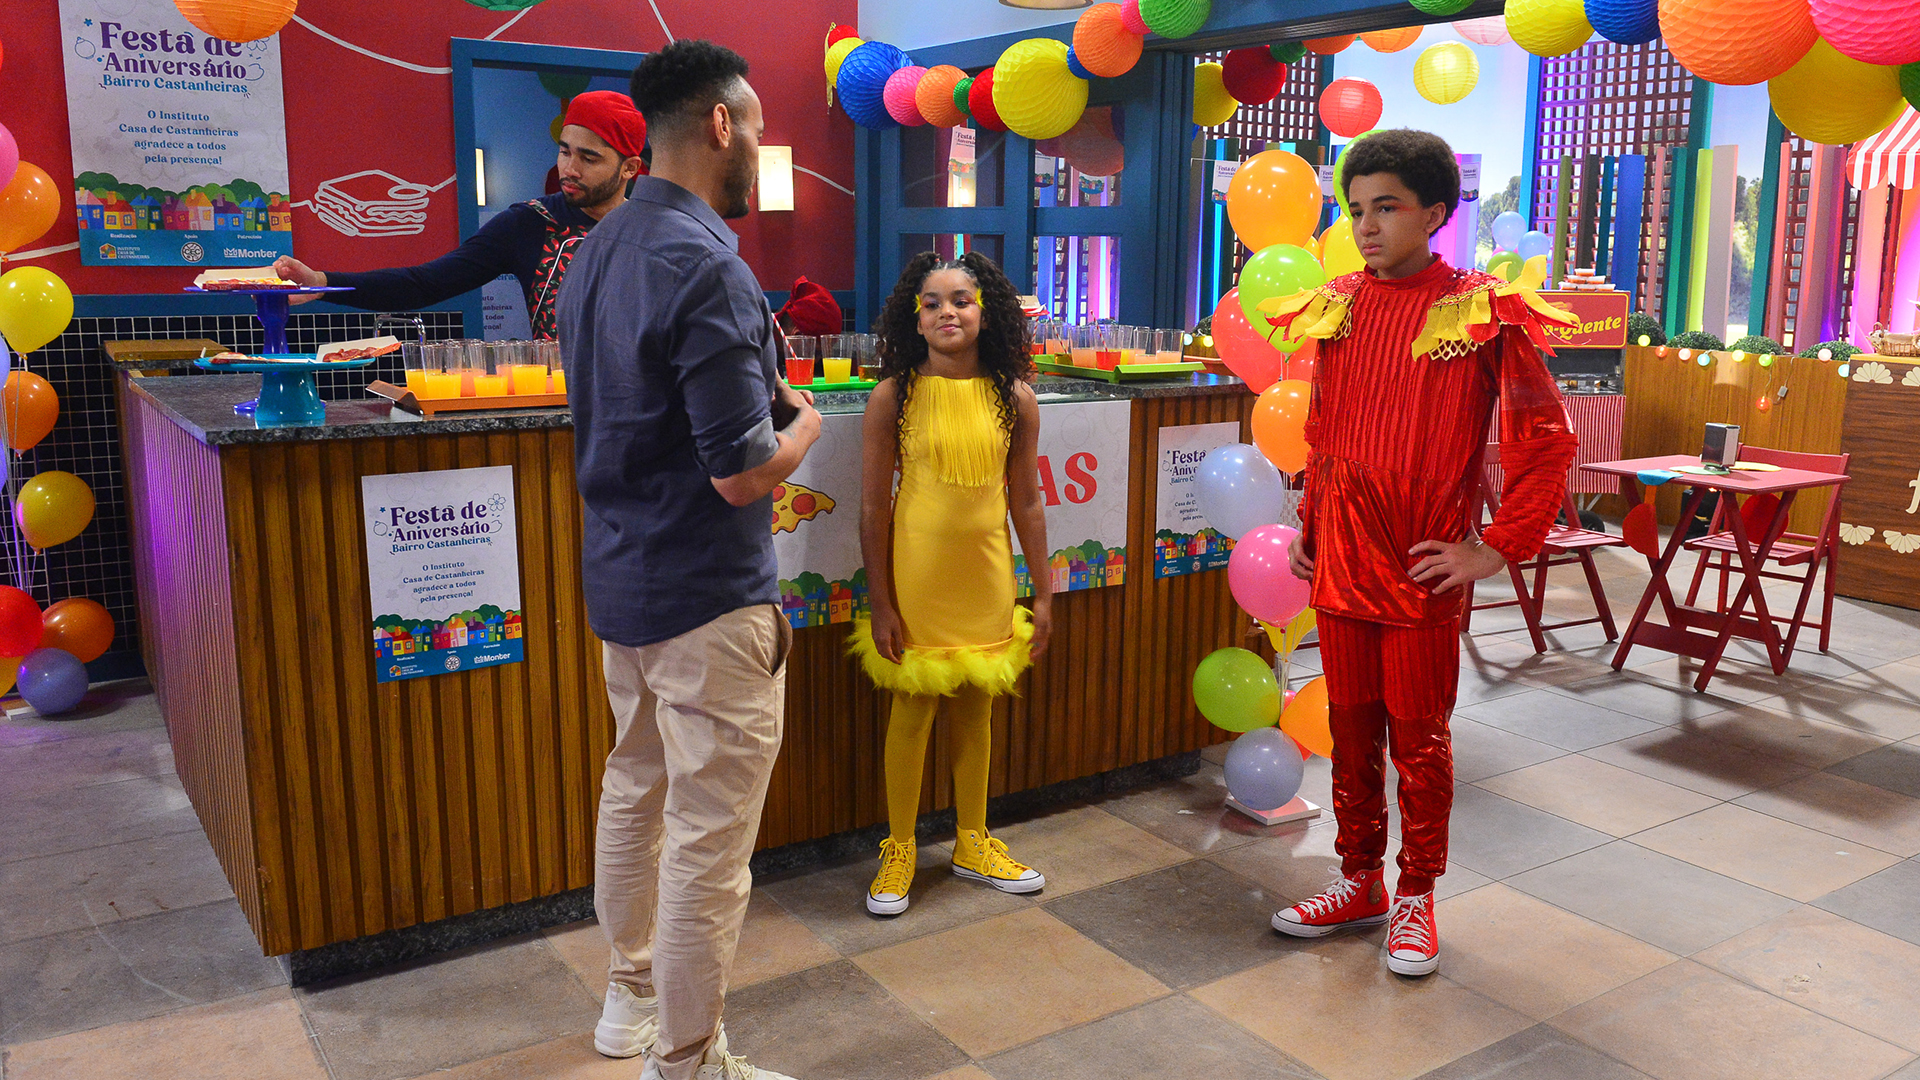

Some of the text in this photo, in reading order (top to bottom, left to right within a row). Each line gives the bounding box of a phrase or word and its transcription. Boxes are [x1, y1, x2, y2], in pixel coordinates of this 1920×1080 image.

[100, 21, 196, 54] Festa
[104, 52, 247, 79] Aniversário
[103, 74, 248, 93] Bairro Castanheiras
[147, 110, 210, 121] O Instituto
[119, 123, 239, 137] Casa de Castanheiras
[134, 140, 184, 150] agradece
[196, 142, 227, 150] todos
[144, 154, 222, 165] pela presença!
[238, 249, 277, 258] Monter
[1037, 452, 1098, 507] AS
[391, 500, 488, 526] Festa de
[393, 521, 490, 542] Aniversário
[392, 536, 491, 553] Bairro Castanheiras
[430, 561, 465, 571] Instituto
[403, 576, 423, 584] Casa
[434, 569, 485, 580] Castanheiras
[413, 583, 447, 594] agradece
[456, 580, 476, 588] todos
[420, 590, 474, 604] pela presença!
[484, 653, 511, 663] Monter
